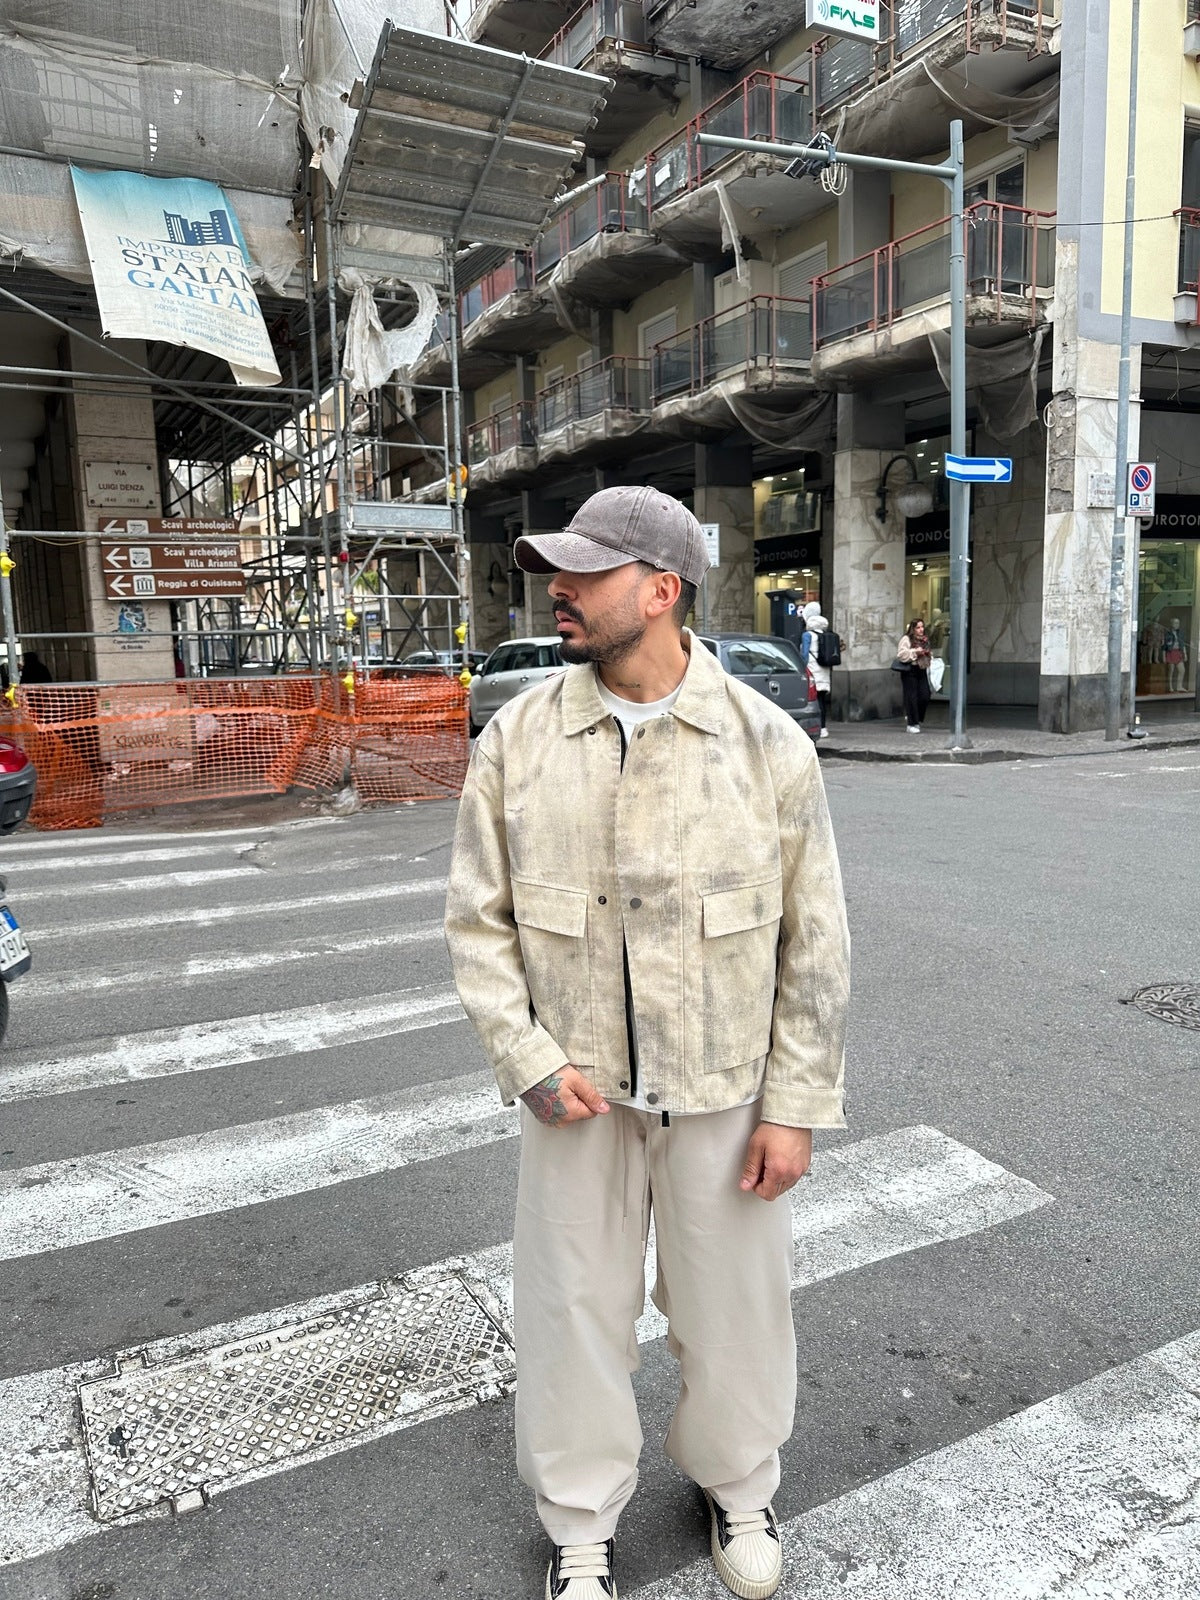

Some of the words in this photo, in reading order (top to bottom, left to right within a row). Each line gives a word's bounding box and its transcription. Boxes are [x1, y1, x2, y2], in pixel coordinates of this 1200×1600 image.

[117, 236, 222, 264] IMPRESA
[120, 483, 145, 491] DENZA
[1131, 495, 1138, 504] P
[161, 520, 183, 529] Scavi
[187, 520, 235, 531] archeologici
[163, 547, 186, 556] Scavi
[189, 547, 237, 558] archeologici
[184, 559, 204, 568] Villa
[207, 559, 238, 568] Arianna
[158, 580, 188, 589] Reggia
[190, 579, 199, 587] di
[201, 579, 242, 587] Quisisana
[788, 603, 796, 615] P
[277, 1321, 335, 1343] open
[222, 1339, 272, 1362] fiber
